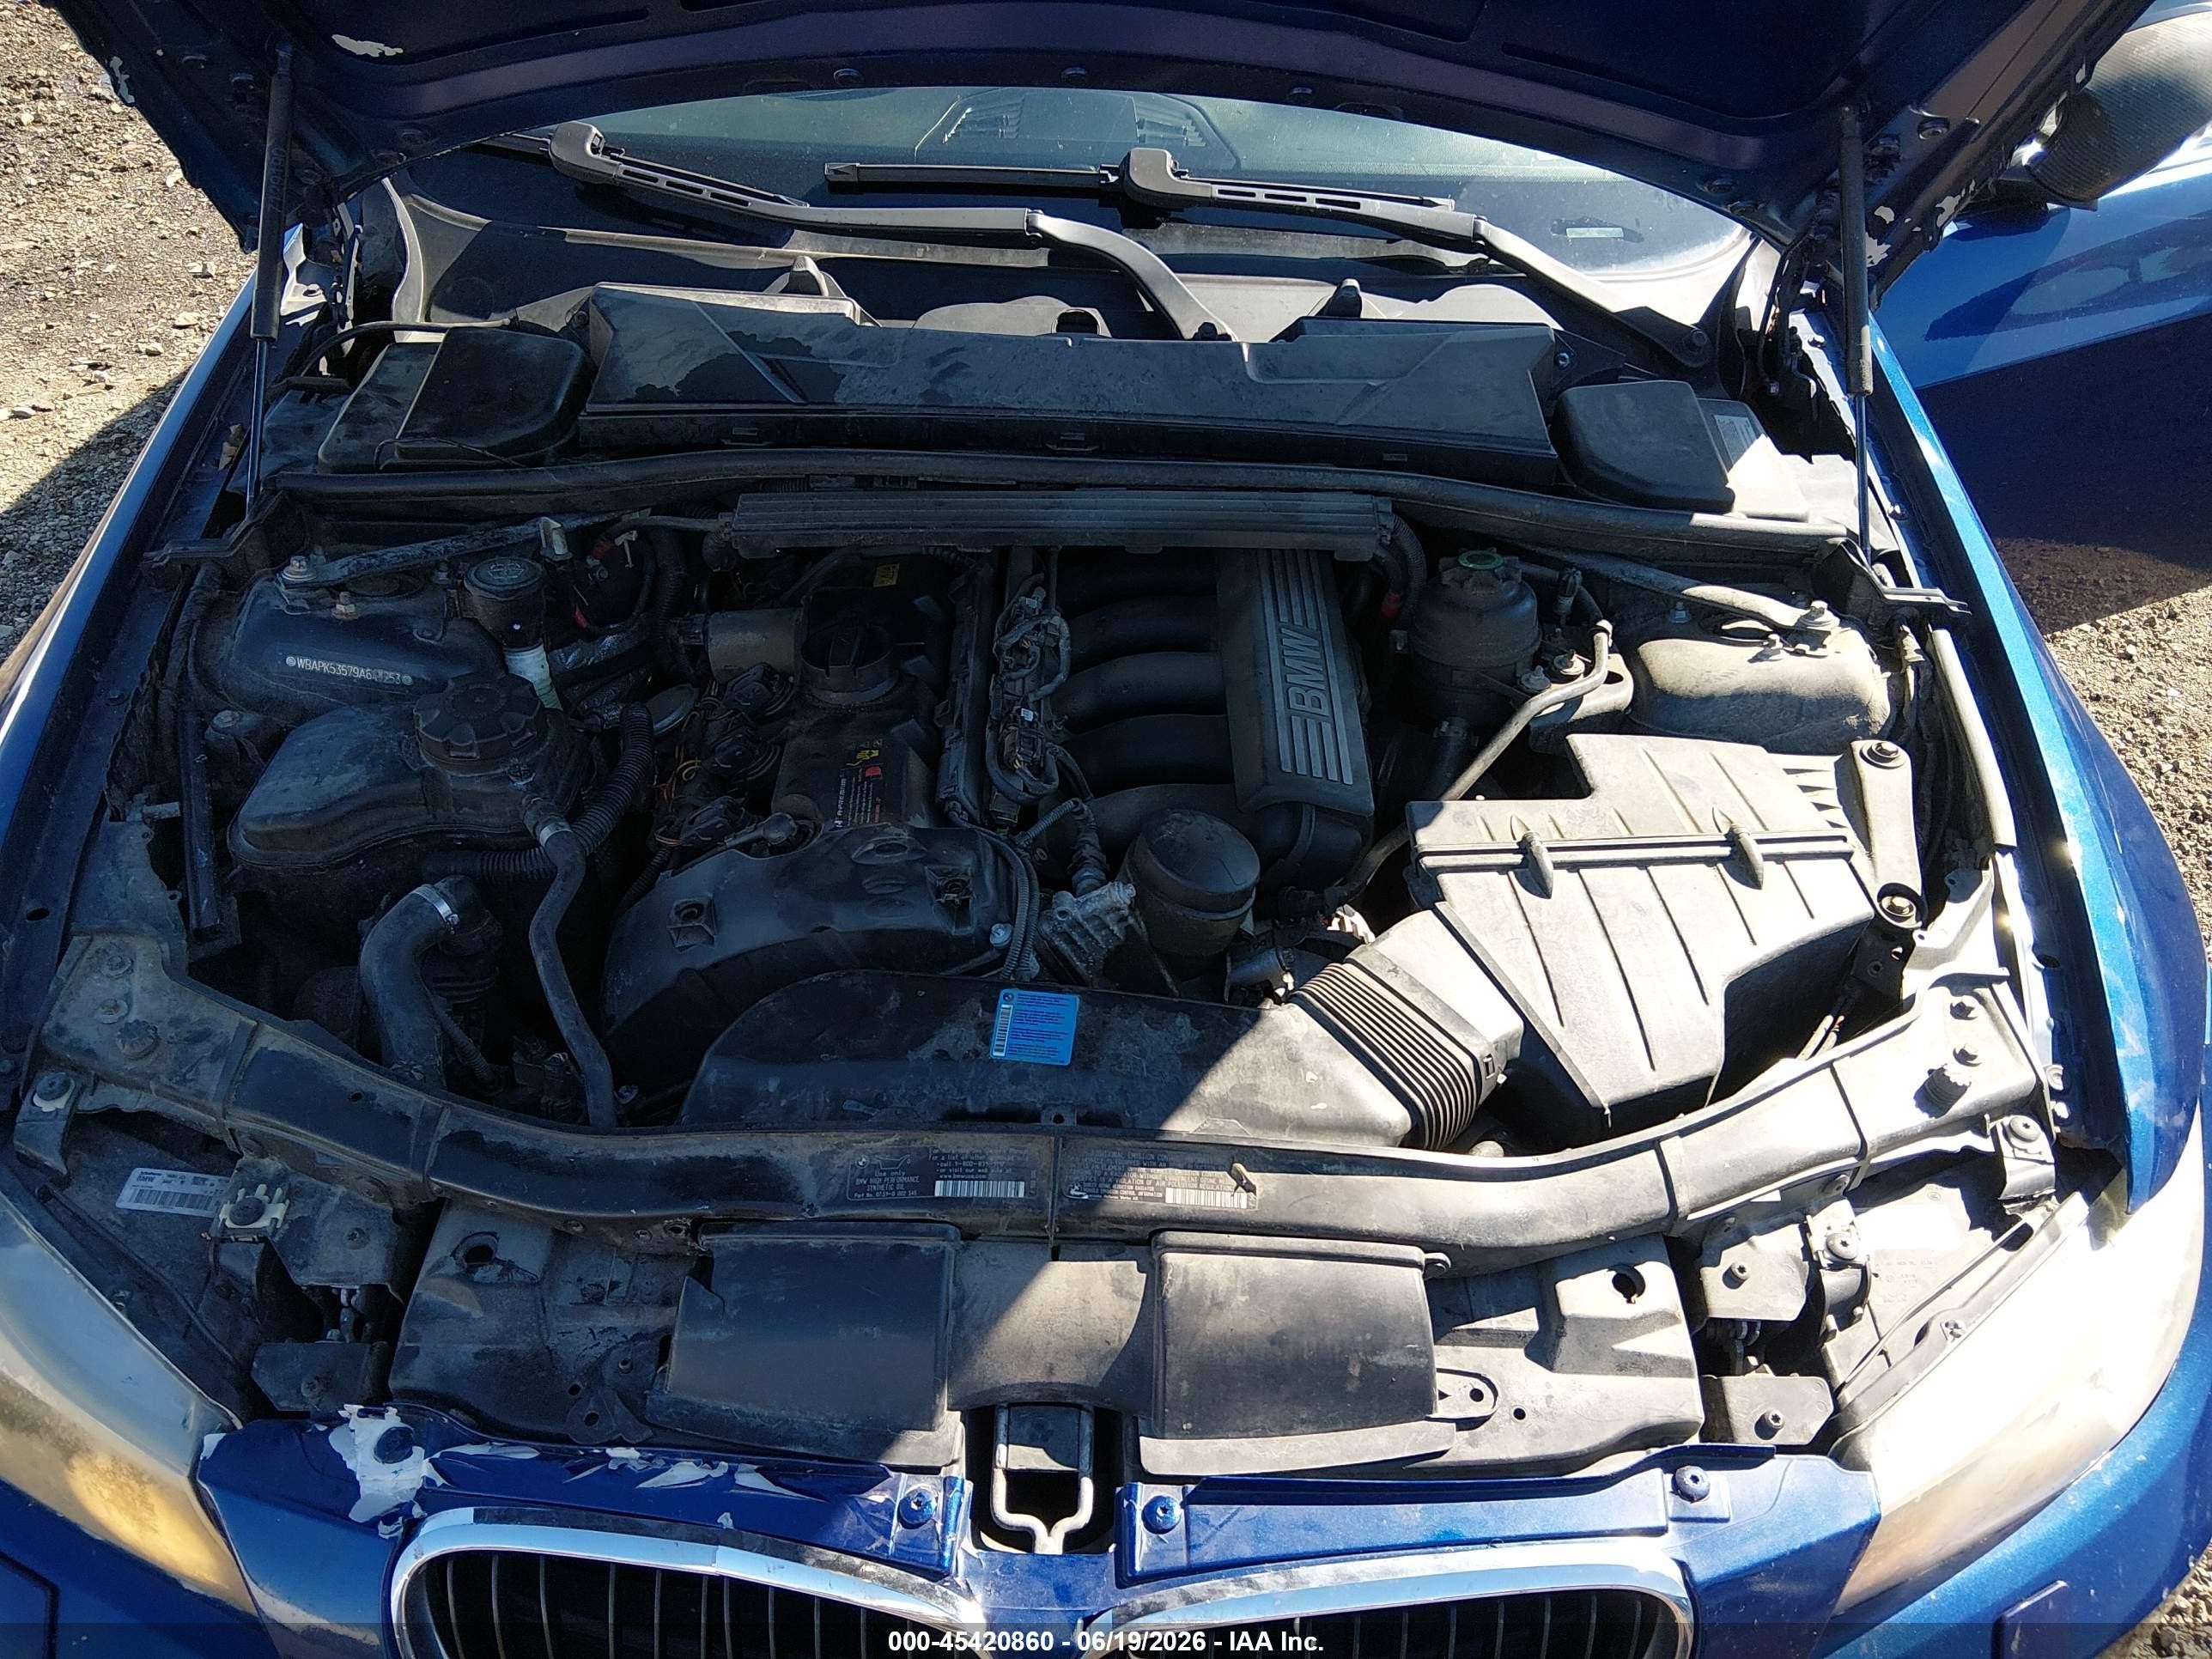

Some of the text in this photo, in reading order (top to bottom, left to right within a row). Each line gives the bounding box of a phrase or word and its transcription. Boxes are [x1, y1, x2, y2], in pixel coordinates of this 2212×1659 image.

[1279, 627, 1331, 718] BMW
[890, 1169, 906, 1177] only
[866, 1183, 895, 1192] SYNTHETIC
